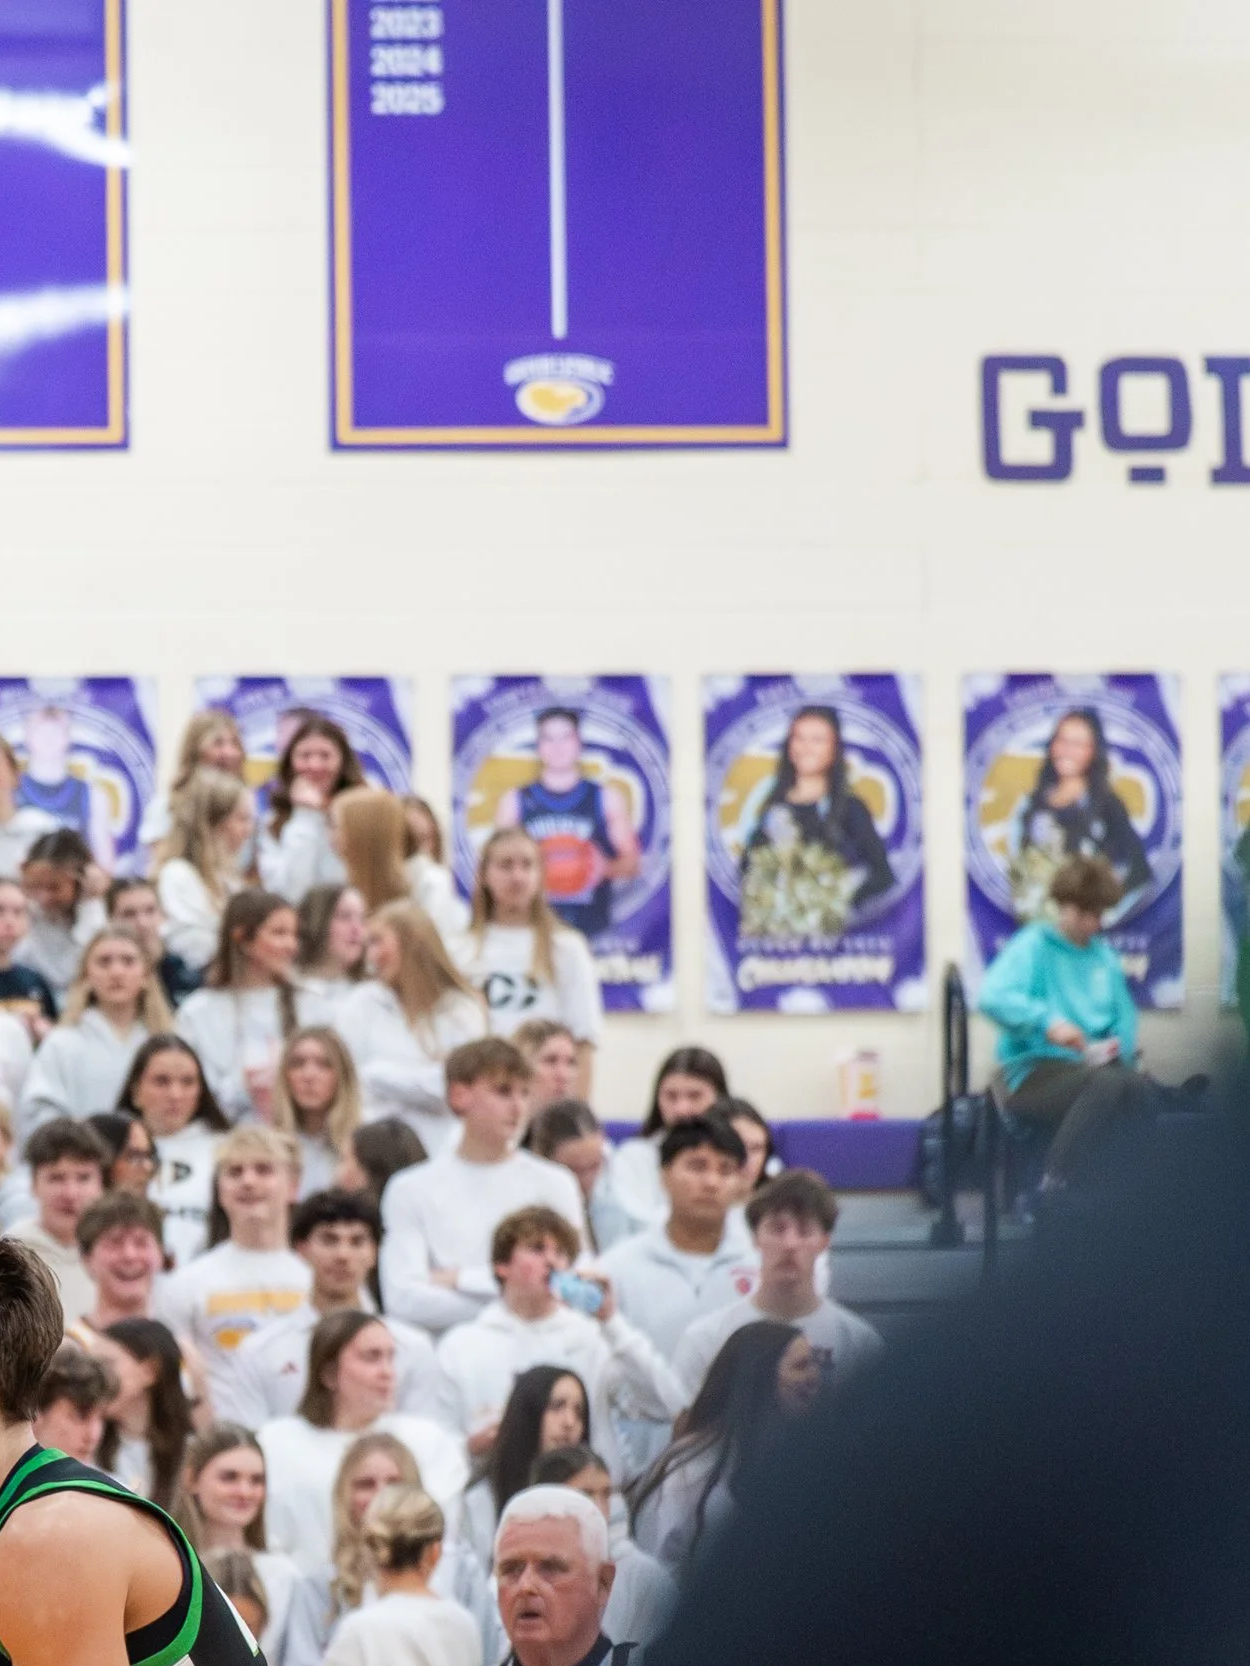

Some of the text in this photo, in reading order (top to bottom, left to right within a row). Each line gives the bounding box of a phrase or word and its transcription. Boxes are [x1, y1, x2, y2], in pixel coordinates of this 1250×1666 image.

[370, 6, 443, 39] 2023
[370, 43, 444, 76] 2024
[371, 82, 446, 115] 2025
